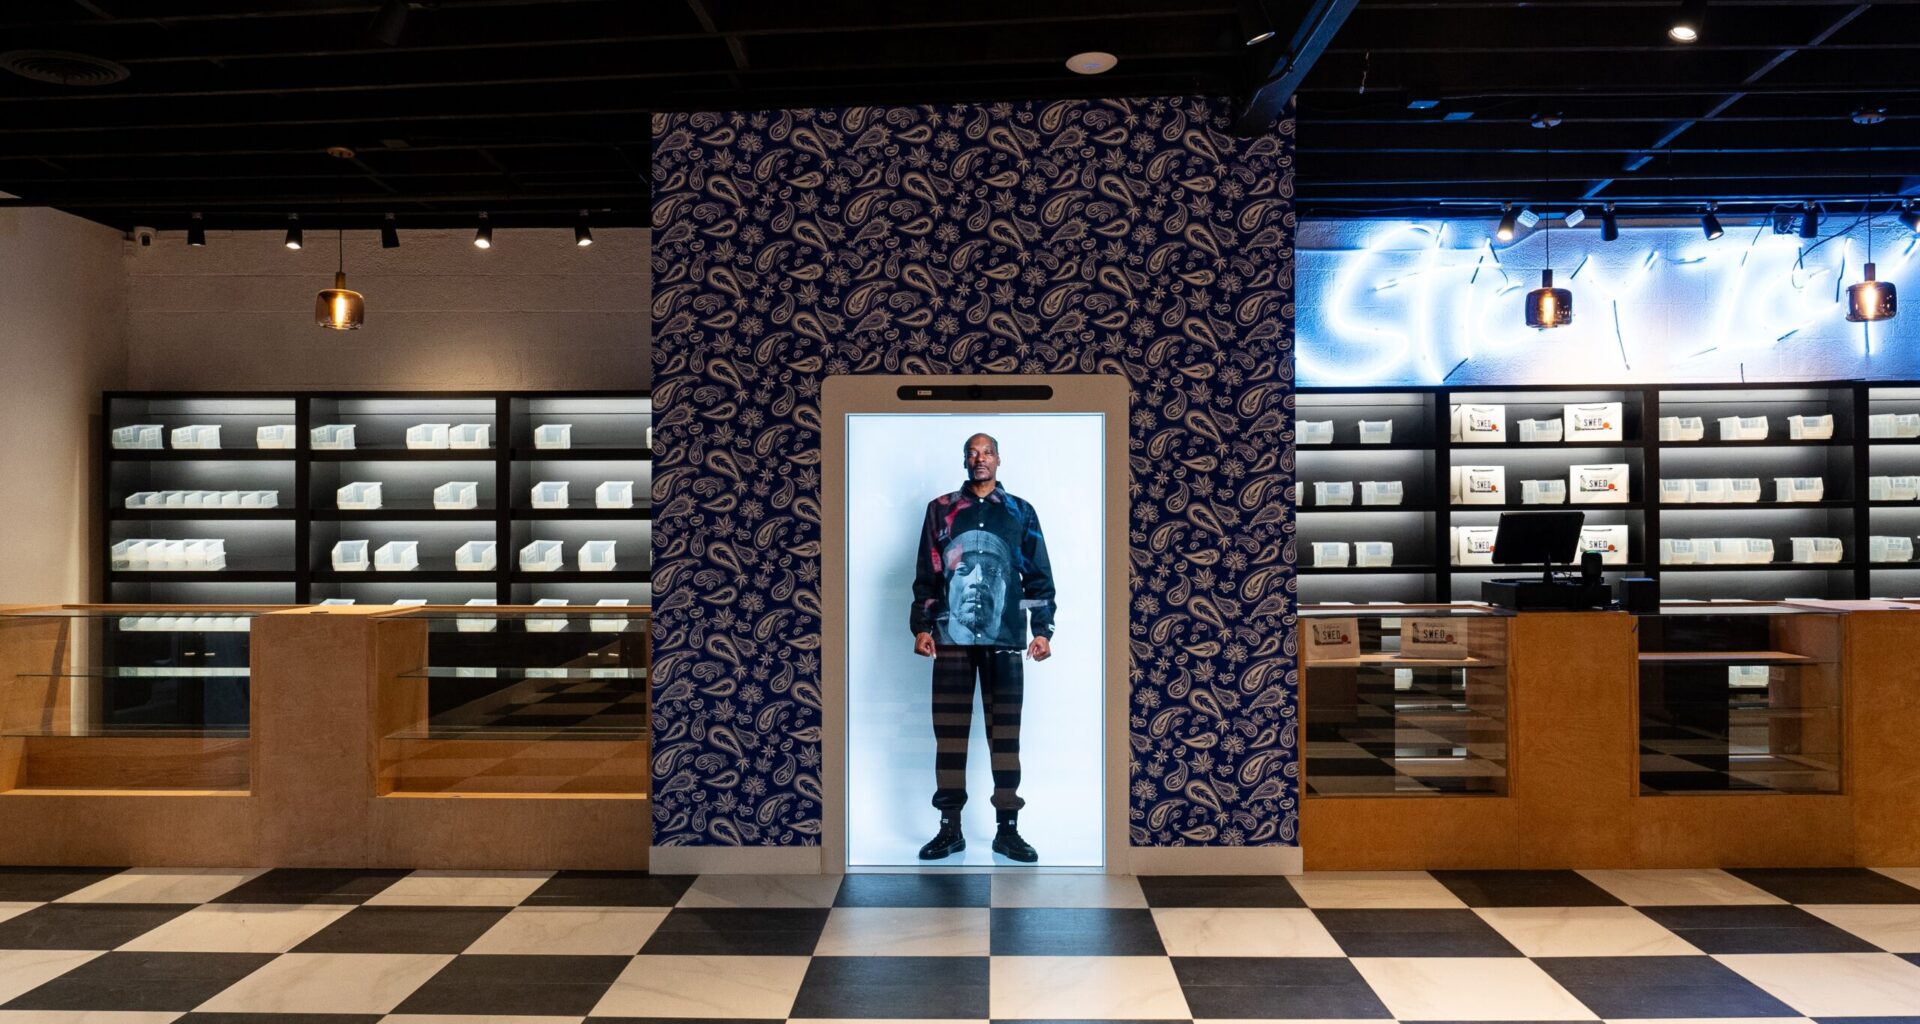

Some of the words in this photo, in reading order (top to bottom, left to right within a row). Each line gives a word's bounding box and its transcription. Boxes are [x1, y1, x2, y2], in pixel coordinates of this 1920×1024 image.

[1476, 419, 1492, 428] SWED
[1583, 418, 1602, 427] SWED
[1476, 480, 1491, 489] SWED
[1589, 479, 1608, 488] SWED
[1474, 541, 1490, 550] SWED
[1589, 540, 1608, 549] SWED
[1322, 630, 1341, 640] SWED
[1423, 629, 1445, 639] SWED
